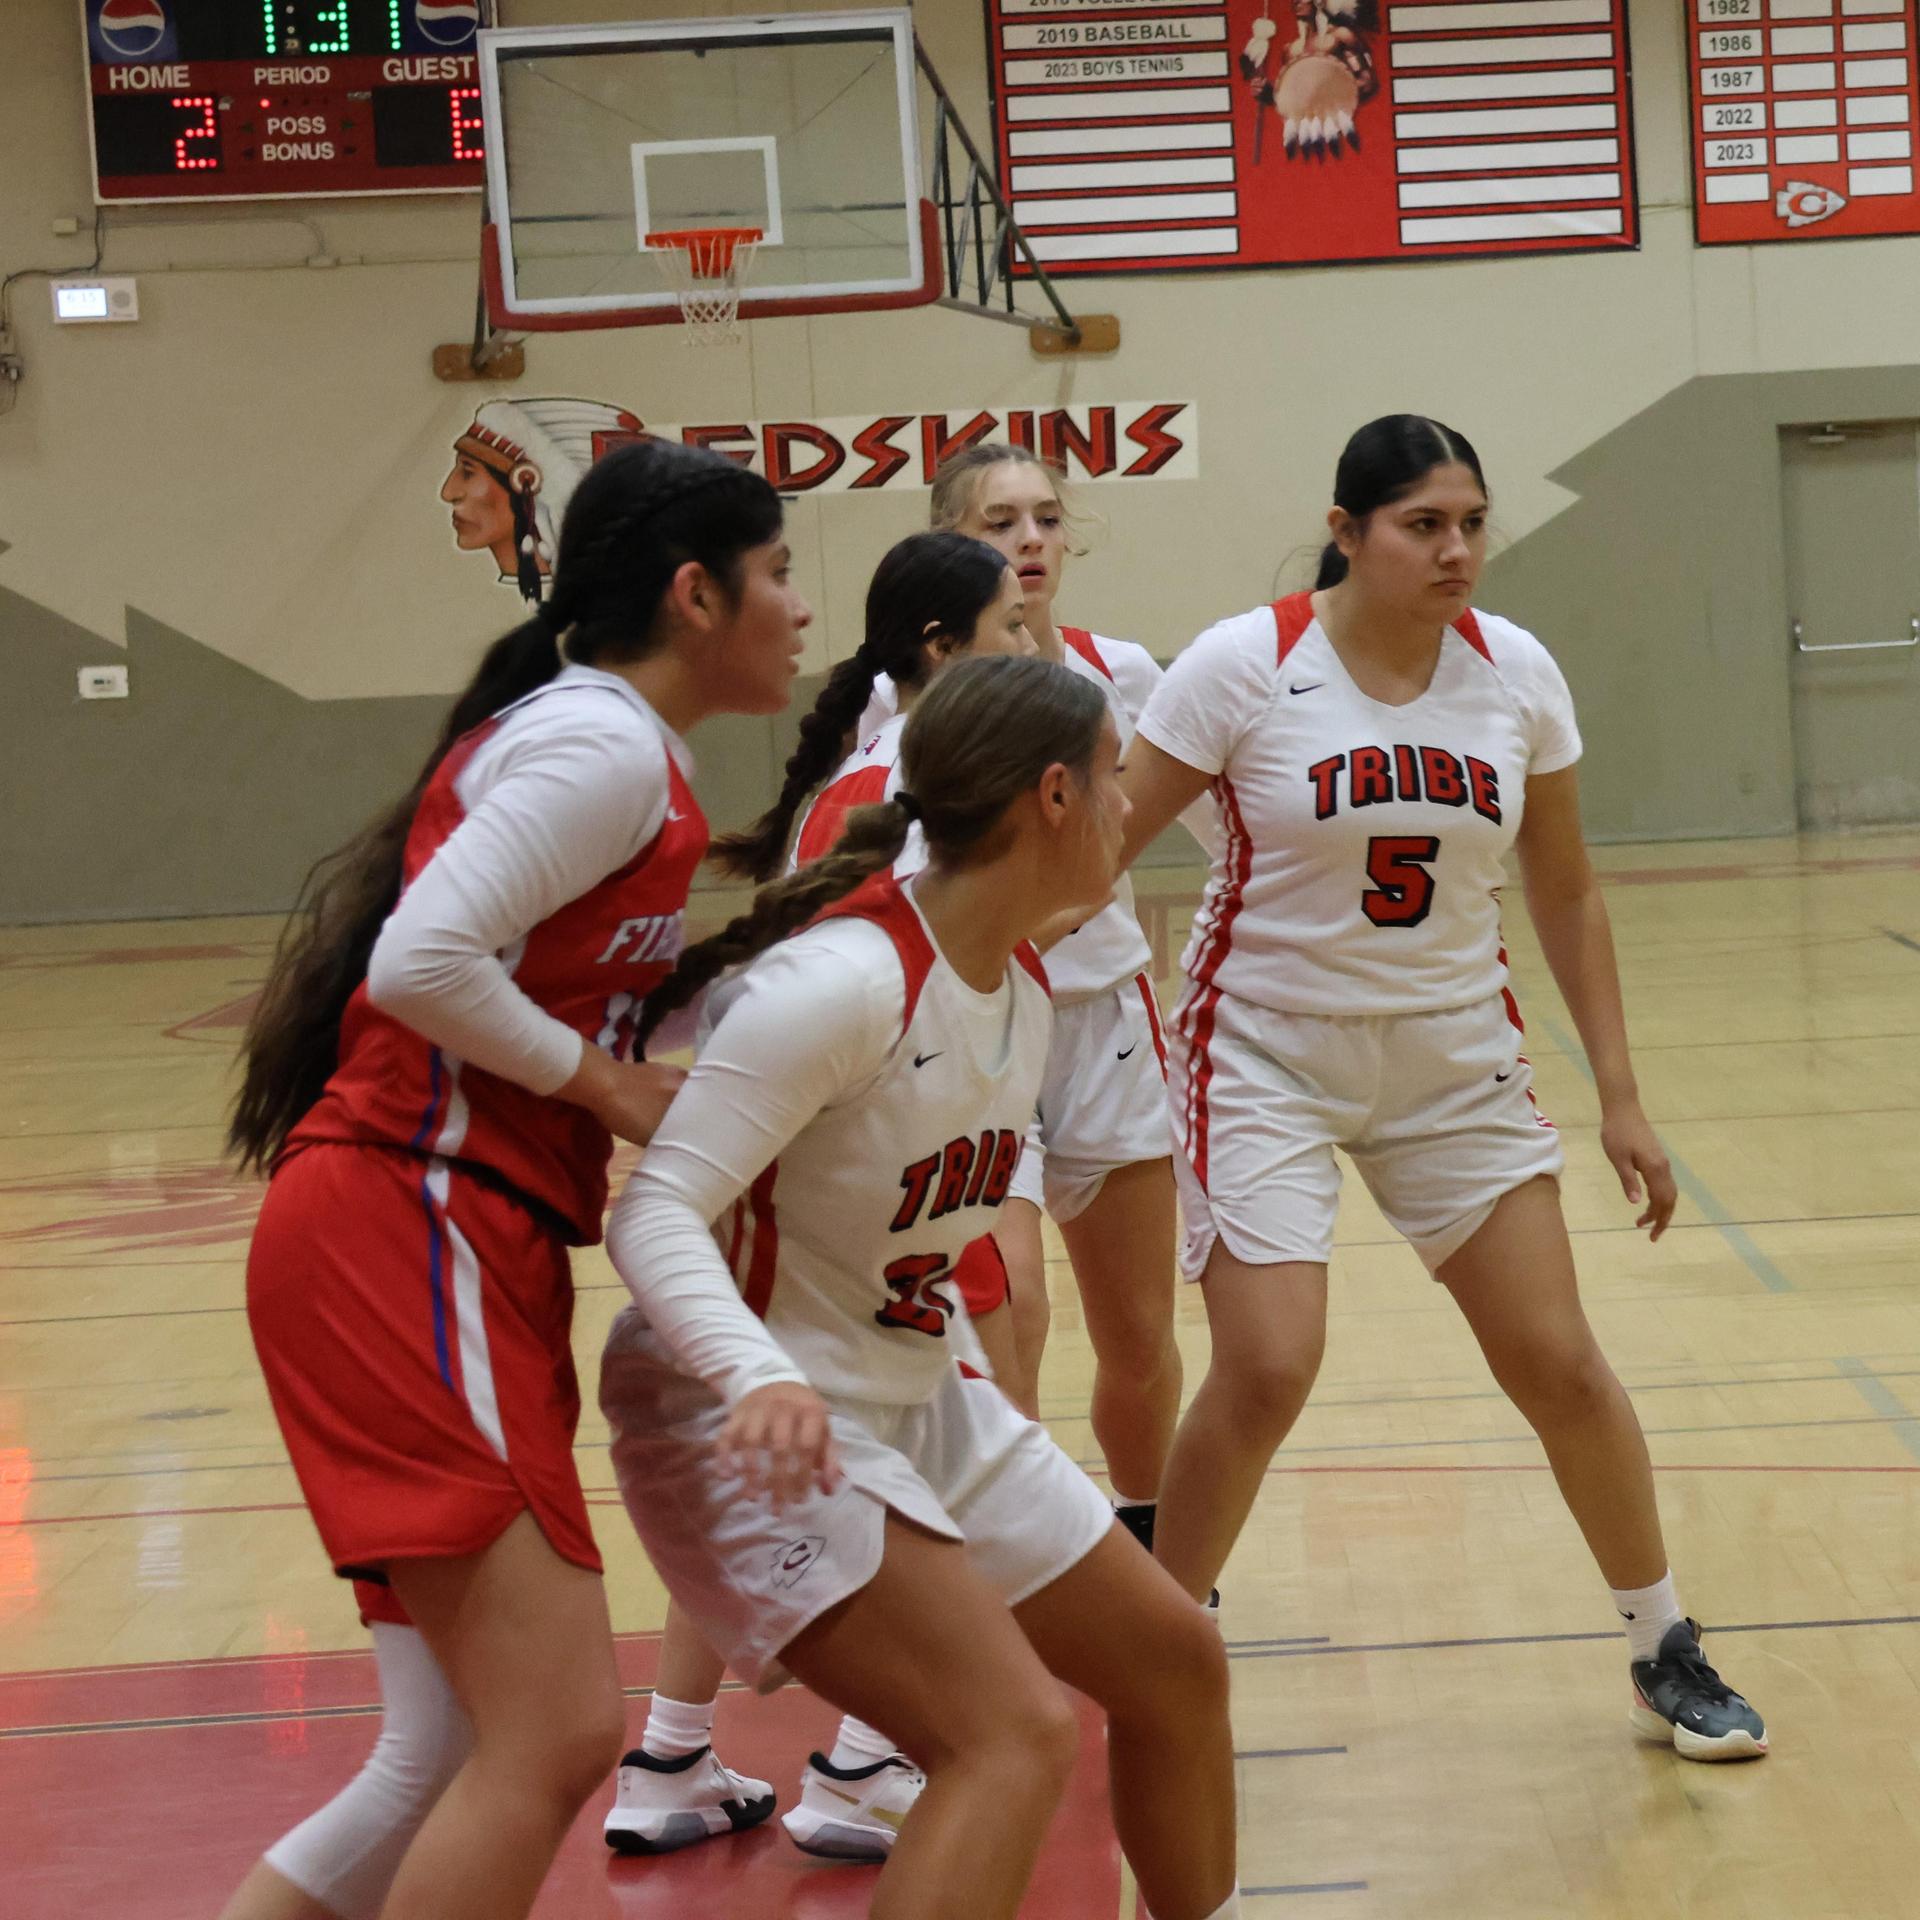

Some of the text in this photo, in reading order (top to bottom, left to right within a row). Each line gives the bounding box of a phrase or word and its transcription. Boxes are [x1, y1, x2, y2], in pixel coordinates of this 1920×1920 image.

[1037, 23, 1192, 44] 2019 BASEBALL
[1709, 36, 1752, 51] 1986
[109, 65, 191, 90] HOME
[254, 66, 331, 85] PERIOD
[383, 56, 475, 81] GUEST
[1045, 57, 1184, 78] 2023 BOYS TENNIS
[1710, 72, 1753, 88] 1987
[267, 116, 327, 136] POSS
[1715, 109, 1753, 126] 2022
[172, 97, 217, 169] 2
[262, 142, 335, 161] BONUS
[1717, 144, 1754, 161] 2023
[1308, 744, 1501, 827] TRIBE
[1361, 836, 1440, 927] 5
[888, 1129, 1025, 1233] TRIB
